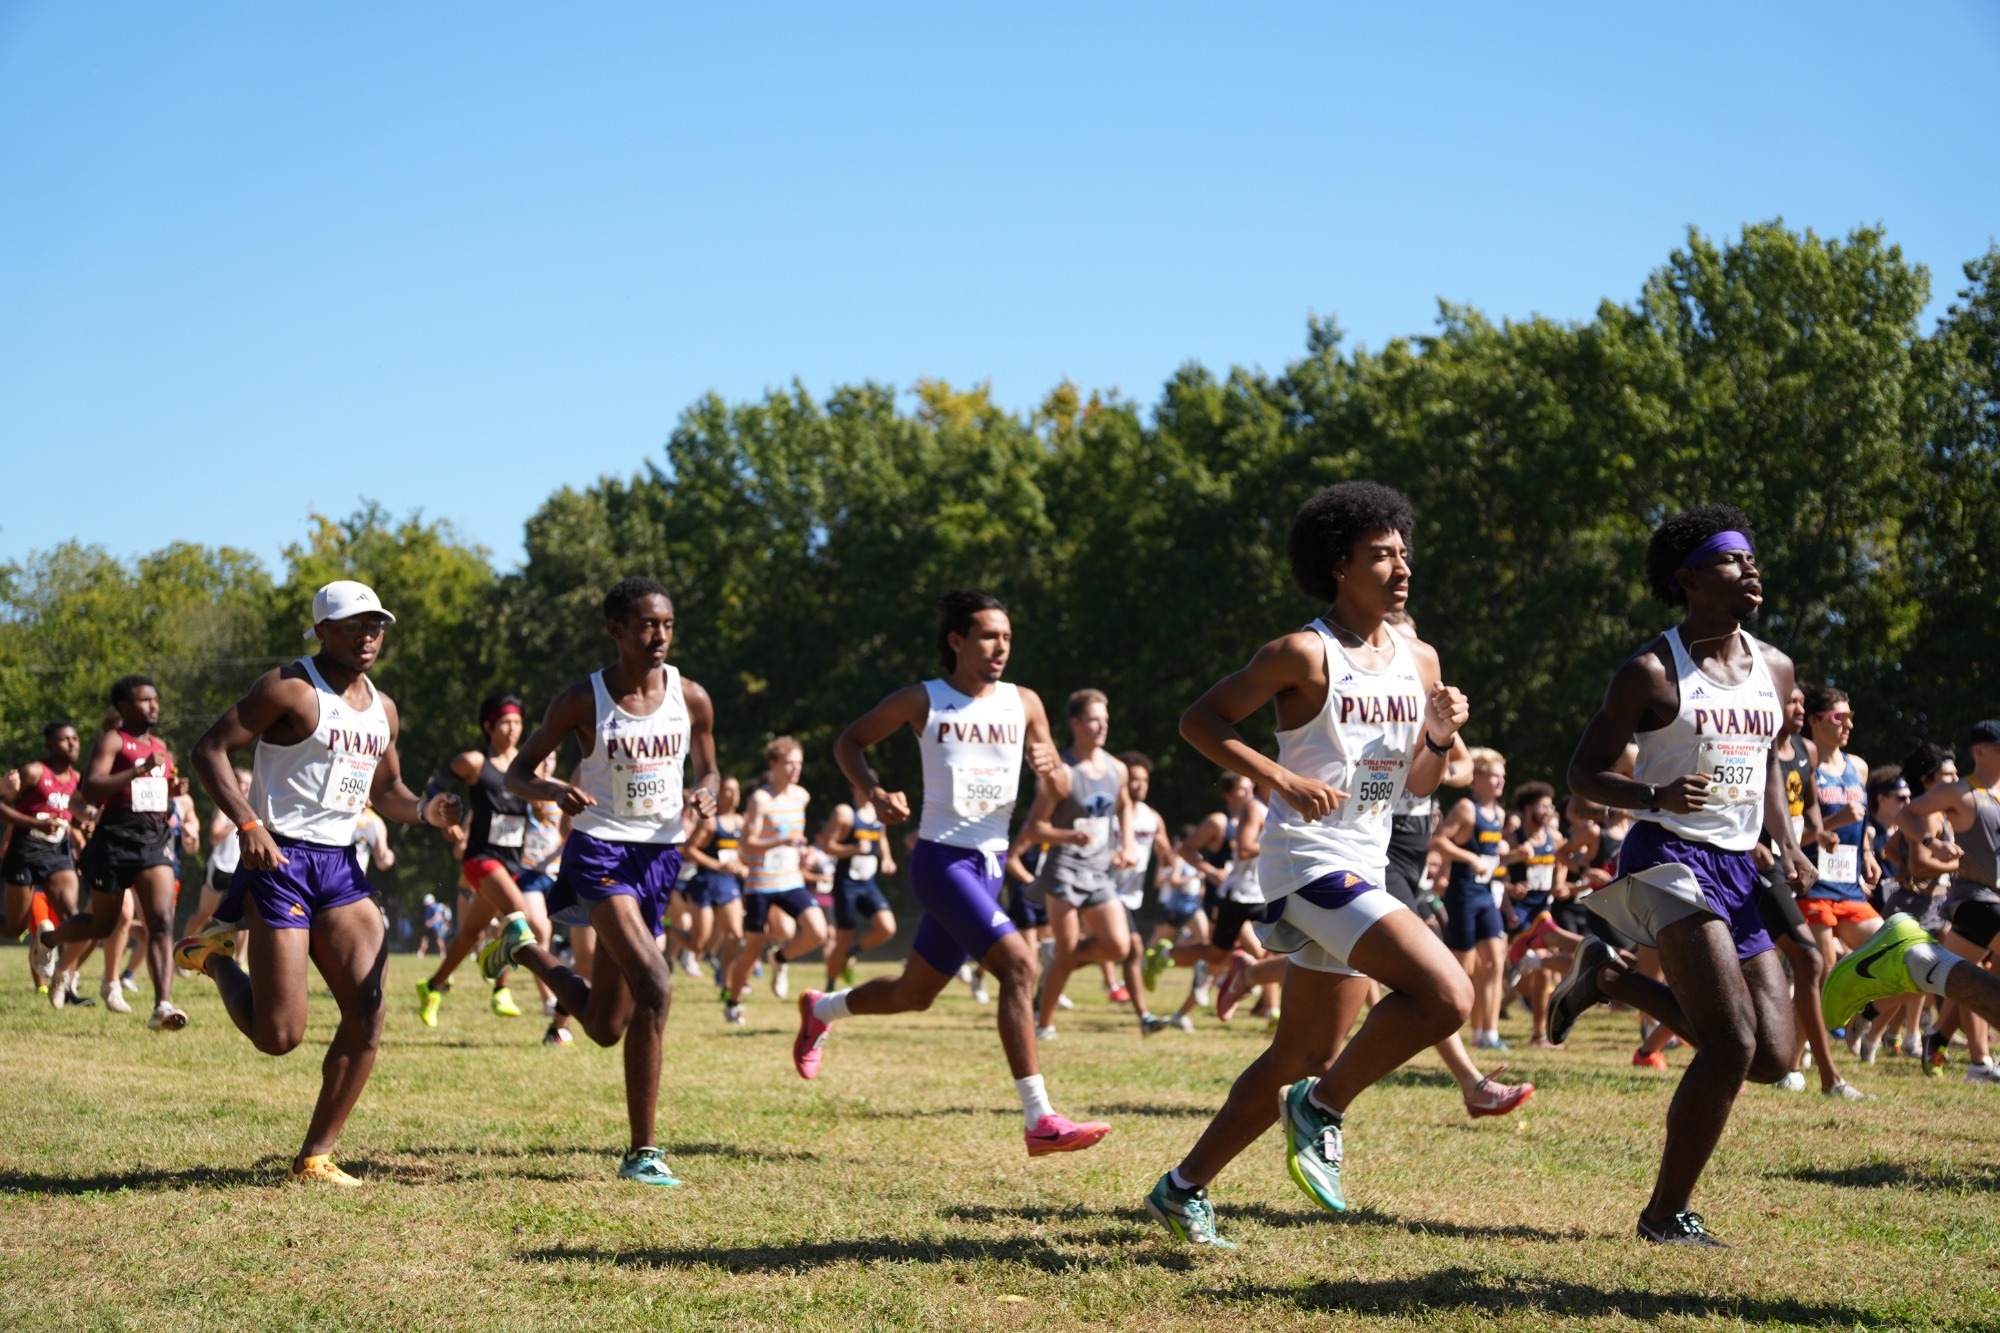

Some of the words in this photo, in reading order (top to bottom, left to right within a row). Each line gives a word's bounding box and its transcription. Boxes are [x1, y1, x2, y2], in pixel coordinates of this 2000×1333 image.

[1339, 695, 1418, 724] PVAMU
[937, 722, 1017, 744] PVAMU
[1694, 708, 1774, 738] PVAMU
[327, 728, 386, 757] PVAMU
[607, 734, 681, 760] PVAMU
[1725, 757, 1746, 765] HOKA
[1370, 772, 1389, 780] HOKA
[1713, 765, 1754, 785] 5337
[339, 777, 368, 795] 5994
[626, 779, 665, 799] 5993
[967, 784, 1002, 800] 5992
[1360, 781, 1394, 801] 5989
